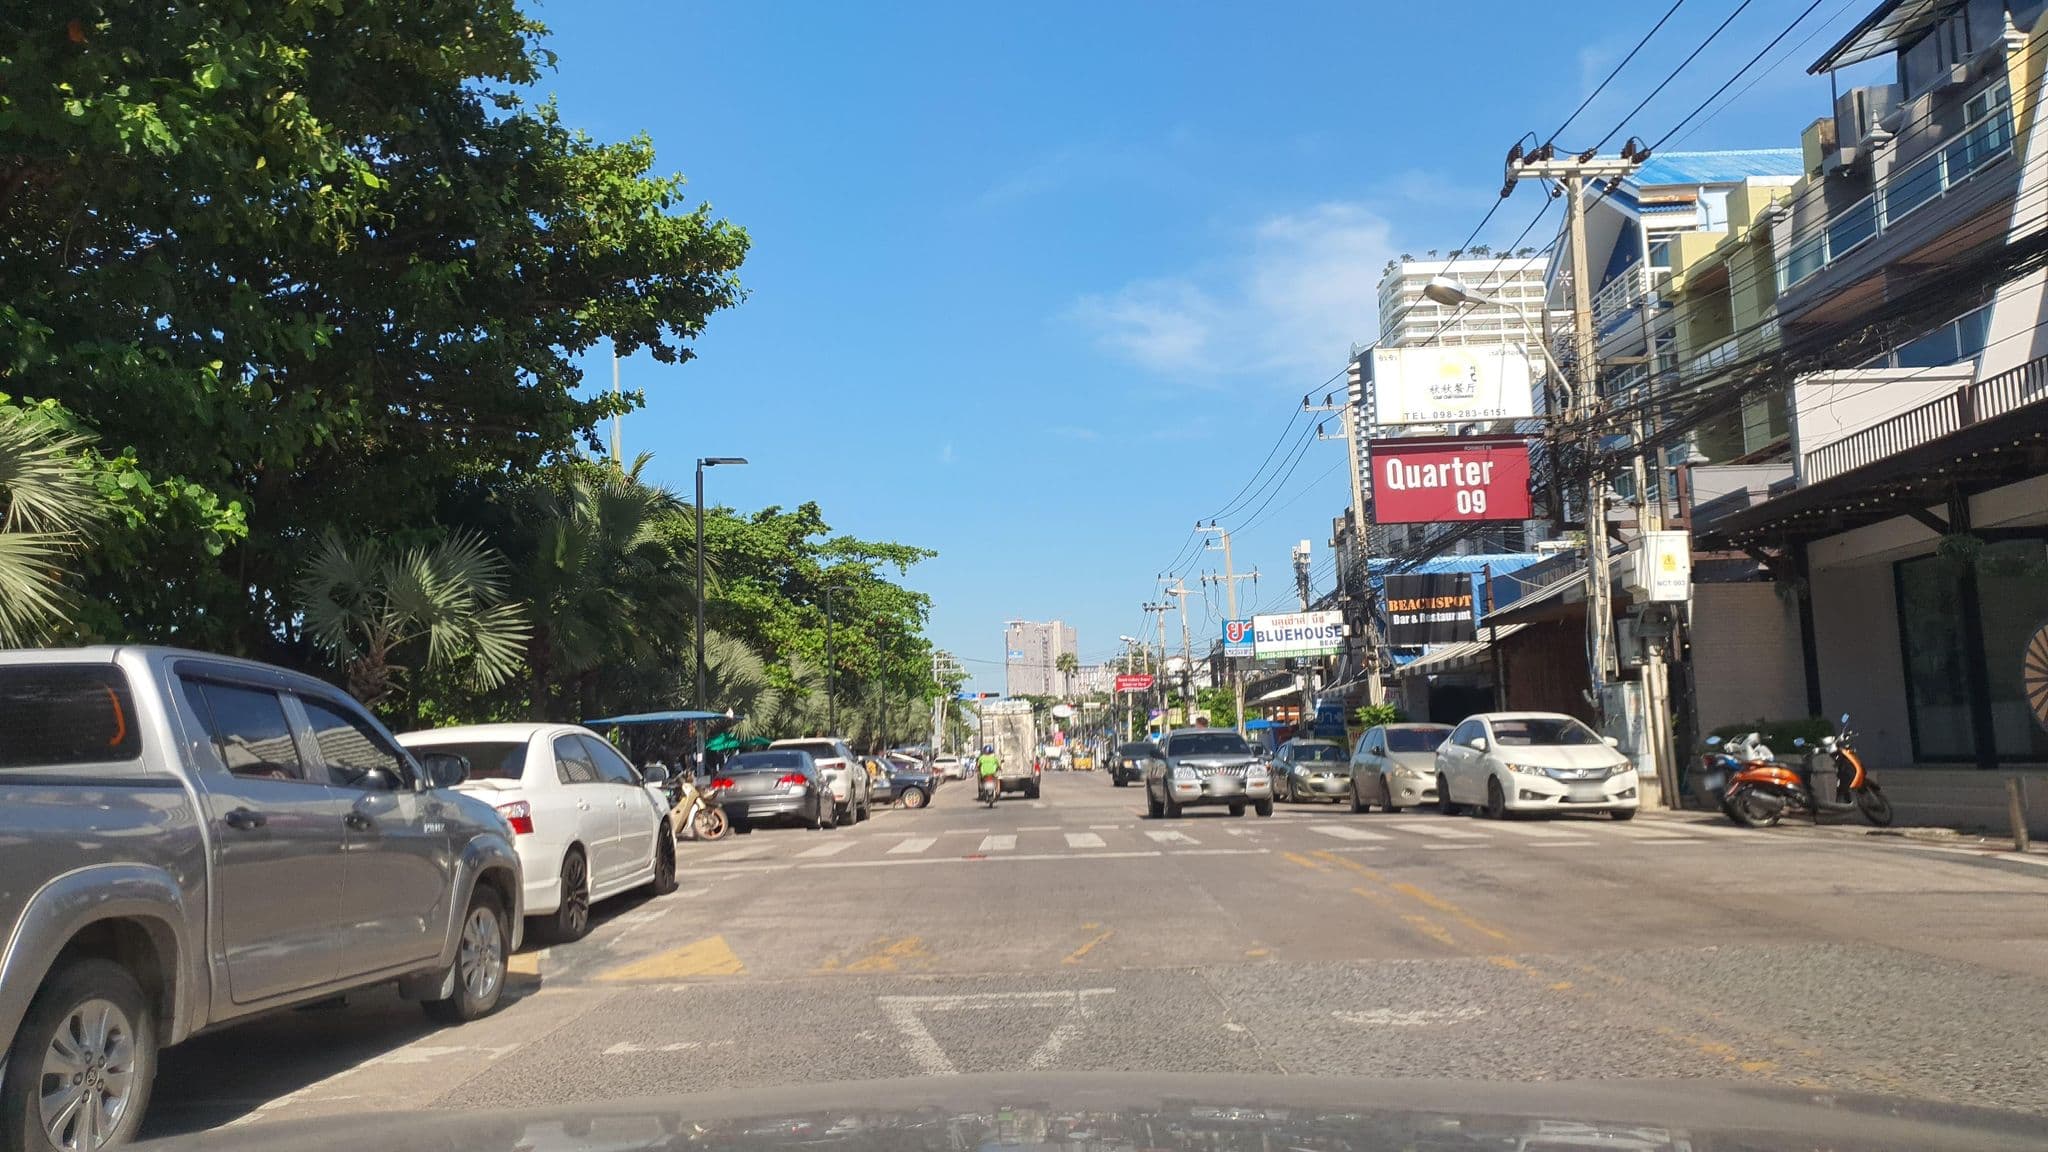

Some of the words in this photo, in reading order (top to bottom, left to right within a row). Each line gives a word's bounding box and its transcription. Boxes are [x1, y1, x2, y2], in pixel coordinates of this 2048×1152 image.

[1433, 408, 1507, 419] 098-283-6151
[1386, 456, 1494, 491] Quarter
[1456, 489, 1487, 514] 09
[1388, 595, 1472, 612] BEACHSPOT
[1256, 625, 1342, 642] BLUEHOUSE
